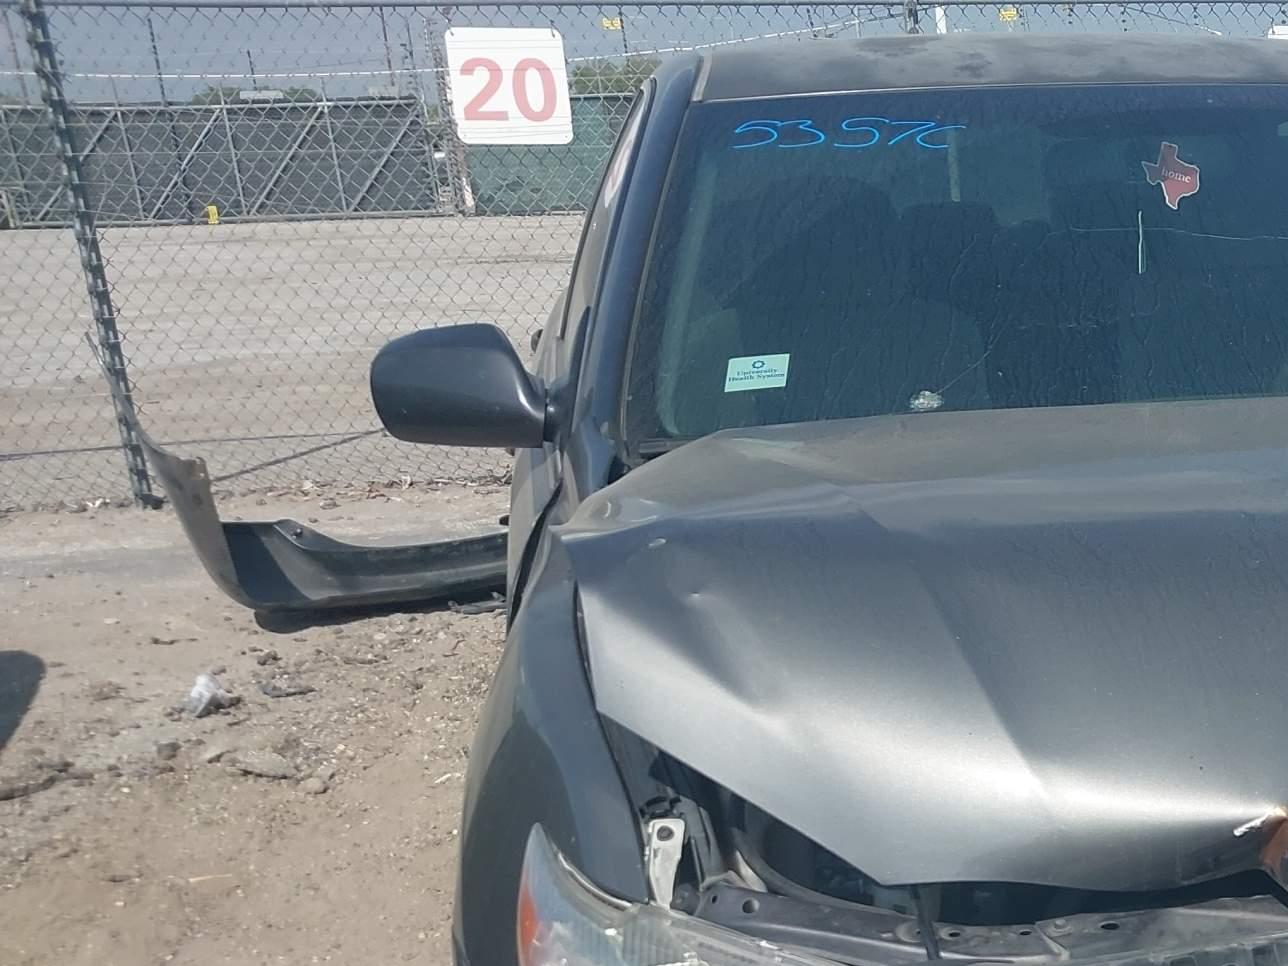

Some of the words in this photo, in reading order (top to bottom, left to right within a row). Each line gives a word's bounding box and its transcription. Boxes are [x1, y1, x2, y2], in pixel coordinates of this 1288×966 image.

[459, 57, 557, 122] 20
[1161, 166, 1192, 183] home
[737, 368, 777, 376] University
